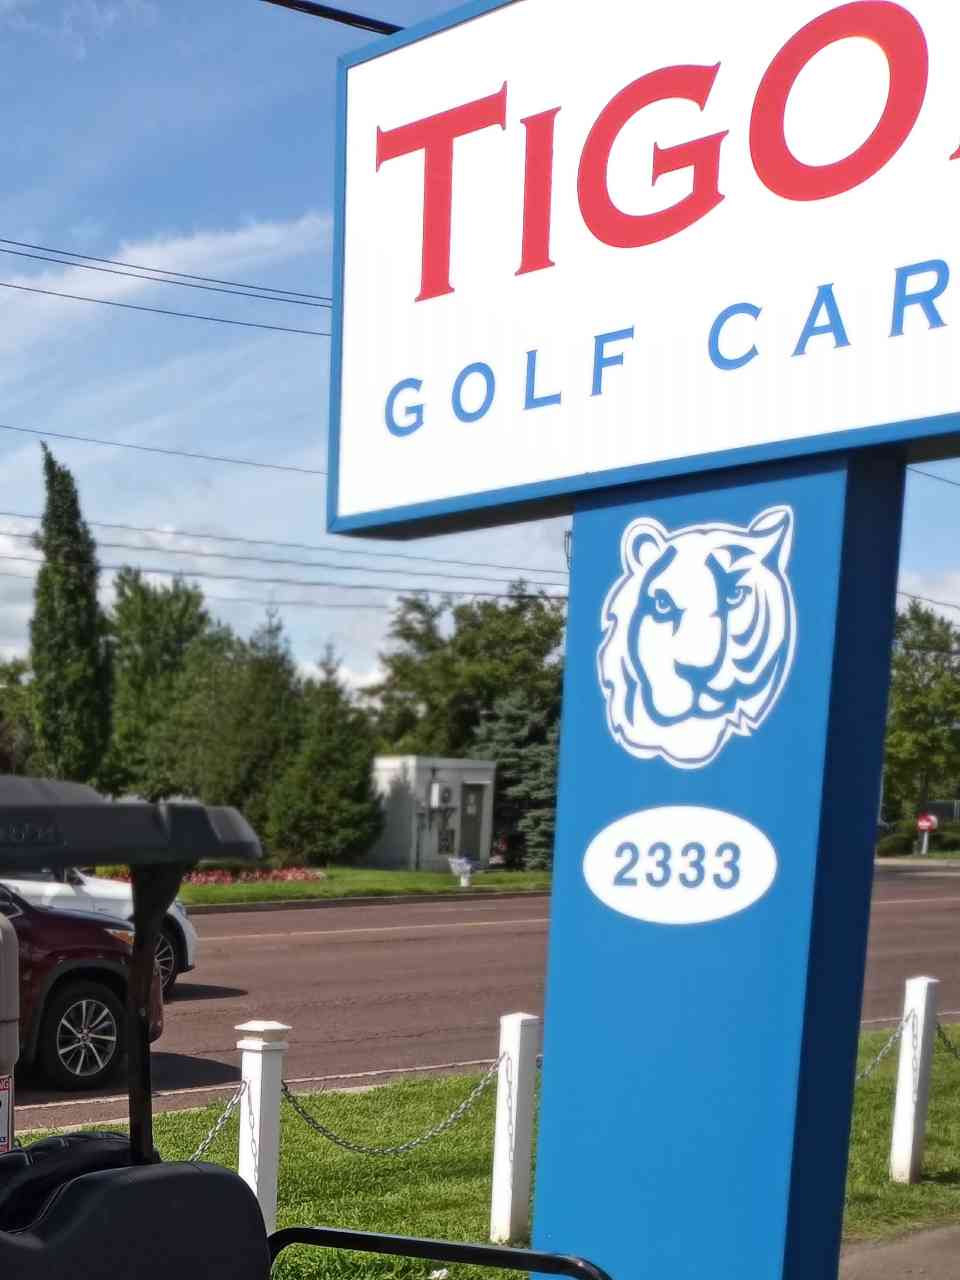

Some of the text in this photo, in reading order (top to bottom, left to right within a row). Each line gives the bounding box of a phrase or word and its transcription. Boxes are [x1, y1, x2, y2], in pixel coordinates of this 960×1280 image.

[376, 0, 960, 302] TIGO
[384, 259, 950, 437] GOLF CAR
[613, 841, 741, 889] 2333
